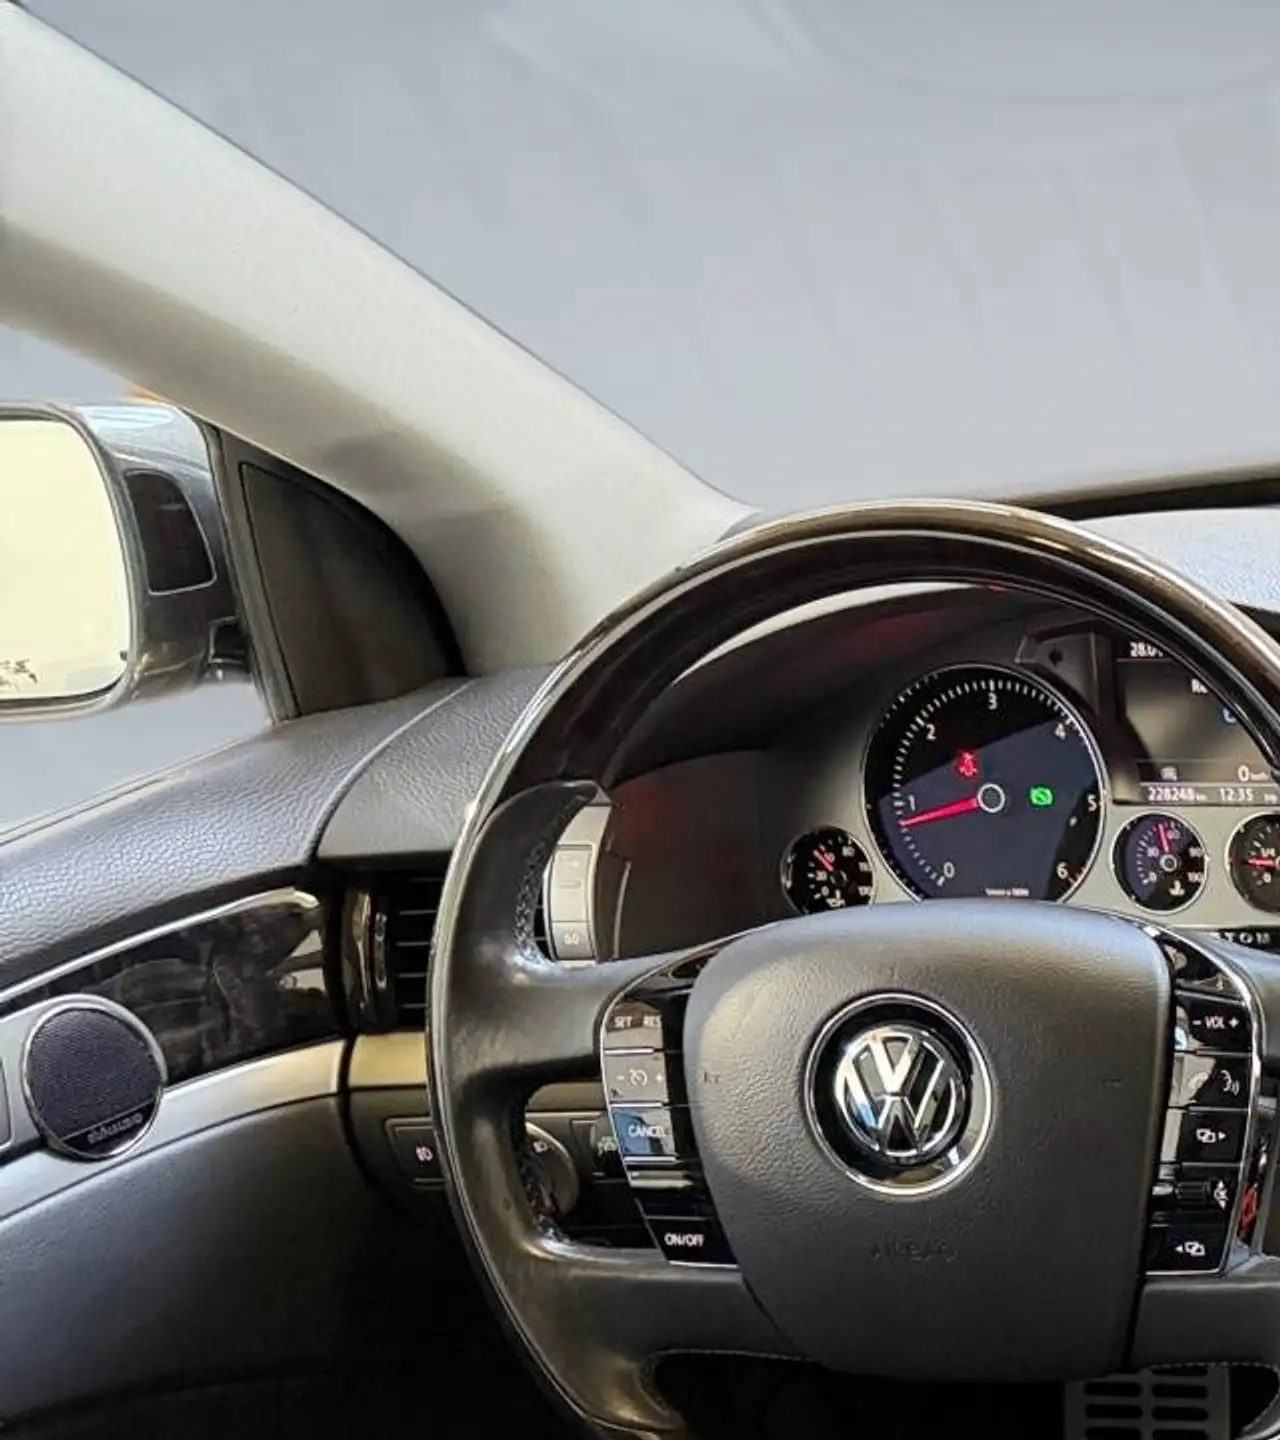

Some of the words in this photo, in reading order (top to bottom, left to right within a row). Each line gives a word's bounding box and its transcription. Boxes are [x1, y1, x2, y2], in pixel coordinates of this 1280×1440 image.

[988, 693, 997, 710] 3
[926, 724, 936, 741] 2
[1055, 723, 1066, 740] 4
[908, 795, 916, 812] 1
[1088, 795, 1097, 812] 5
[943, 862, 955, 878] 0
[1057, 862, 1068, 879] 6
[664, 1232, 704, 1248] ON/OFF
